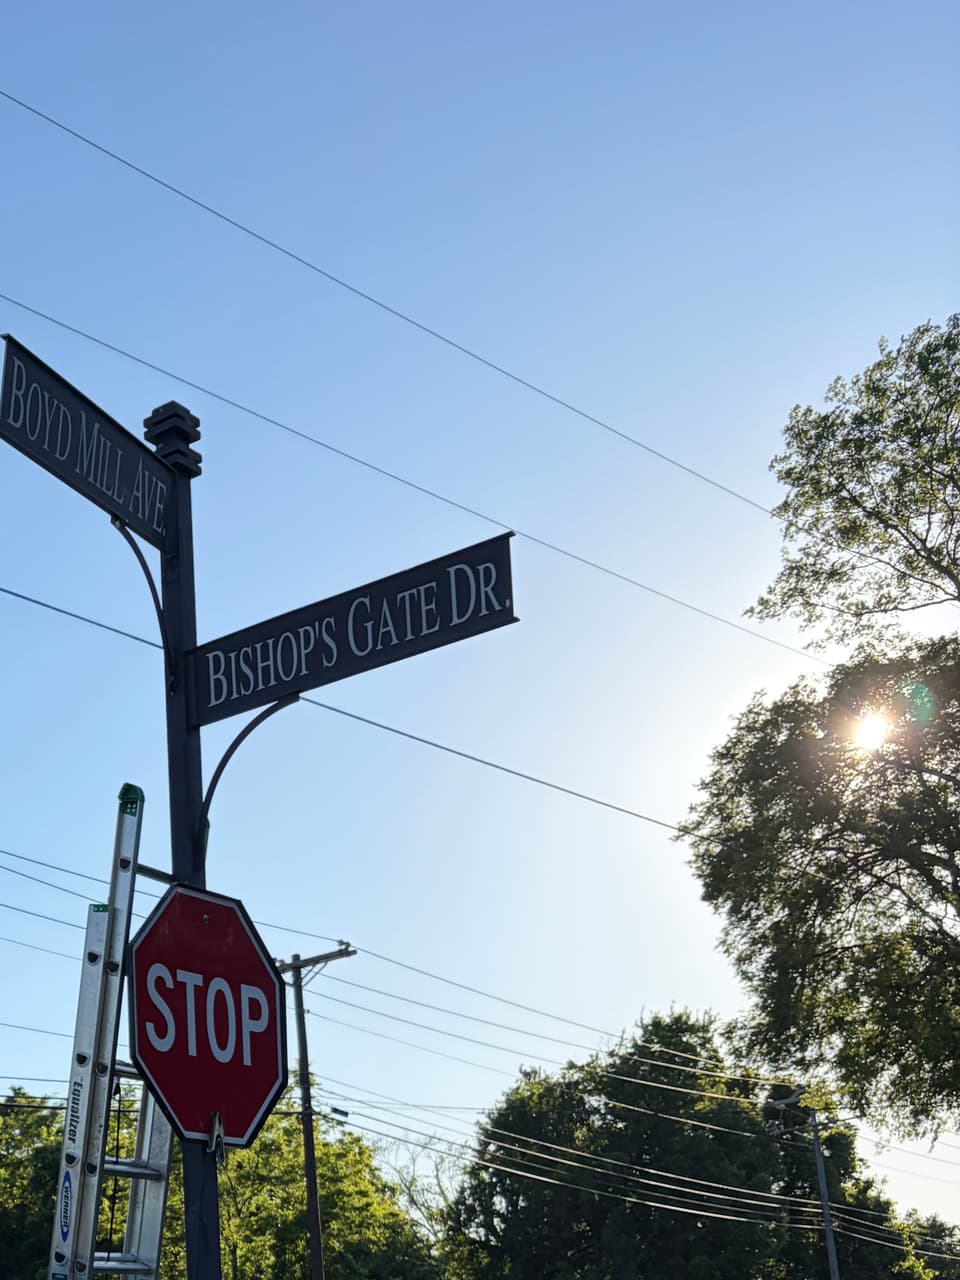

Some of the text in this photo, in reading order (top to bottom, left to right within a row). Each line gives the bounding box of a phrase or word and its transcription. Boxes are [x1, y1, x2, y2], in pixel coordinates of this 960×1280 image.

[7, 356, 167, 536] BOYD MILL AVE.
[206, 562, 512, 707] BISHOP'S GATE DR.
[145, 963, 269, 1065] STOP
